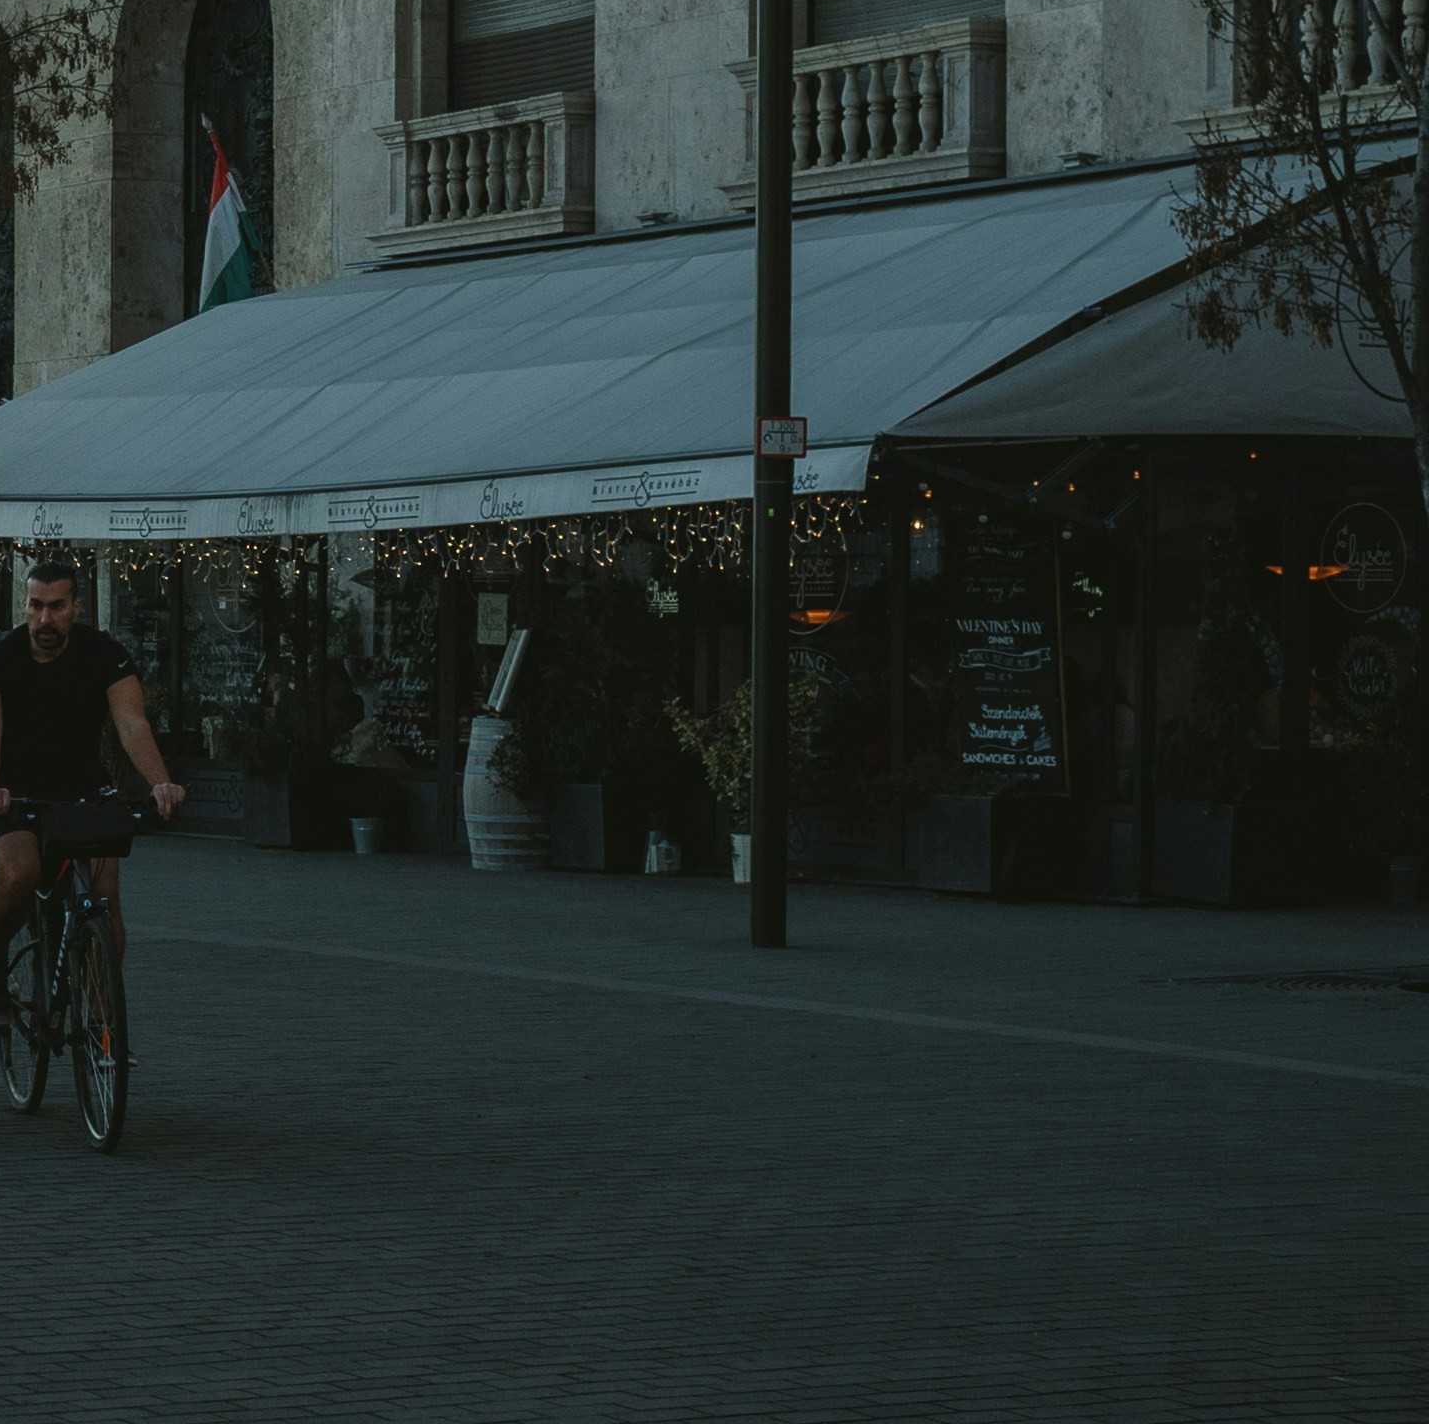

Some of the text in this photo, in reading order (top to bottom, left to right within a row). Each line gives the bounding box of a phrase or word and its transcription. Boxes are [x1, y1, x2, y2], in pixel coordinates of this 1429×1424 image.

[592, 470, 701, 507] Bistro & Kávéház
[139, 506, 152, 538] &
[327, 506, 365, 518] Bistro
[363, 494, 379, 530] &
[1021, 620, 1044, 635] DAY
[961, 752, 1017, 766] SANDWICHES
[1026, 754, 1058, 768] CAKES
